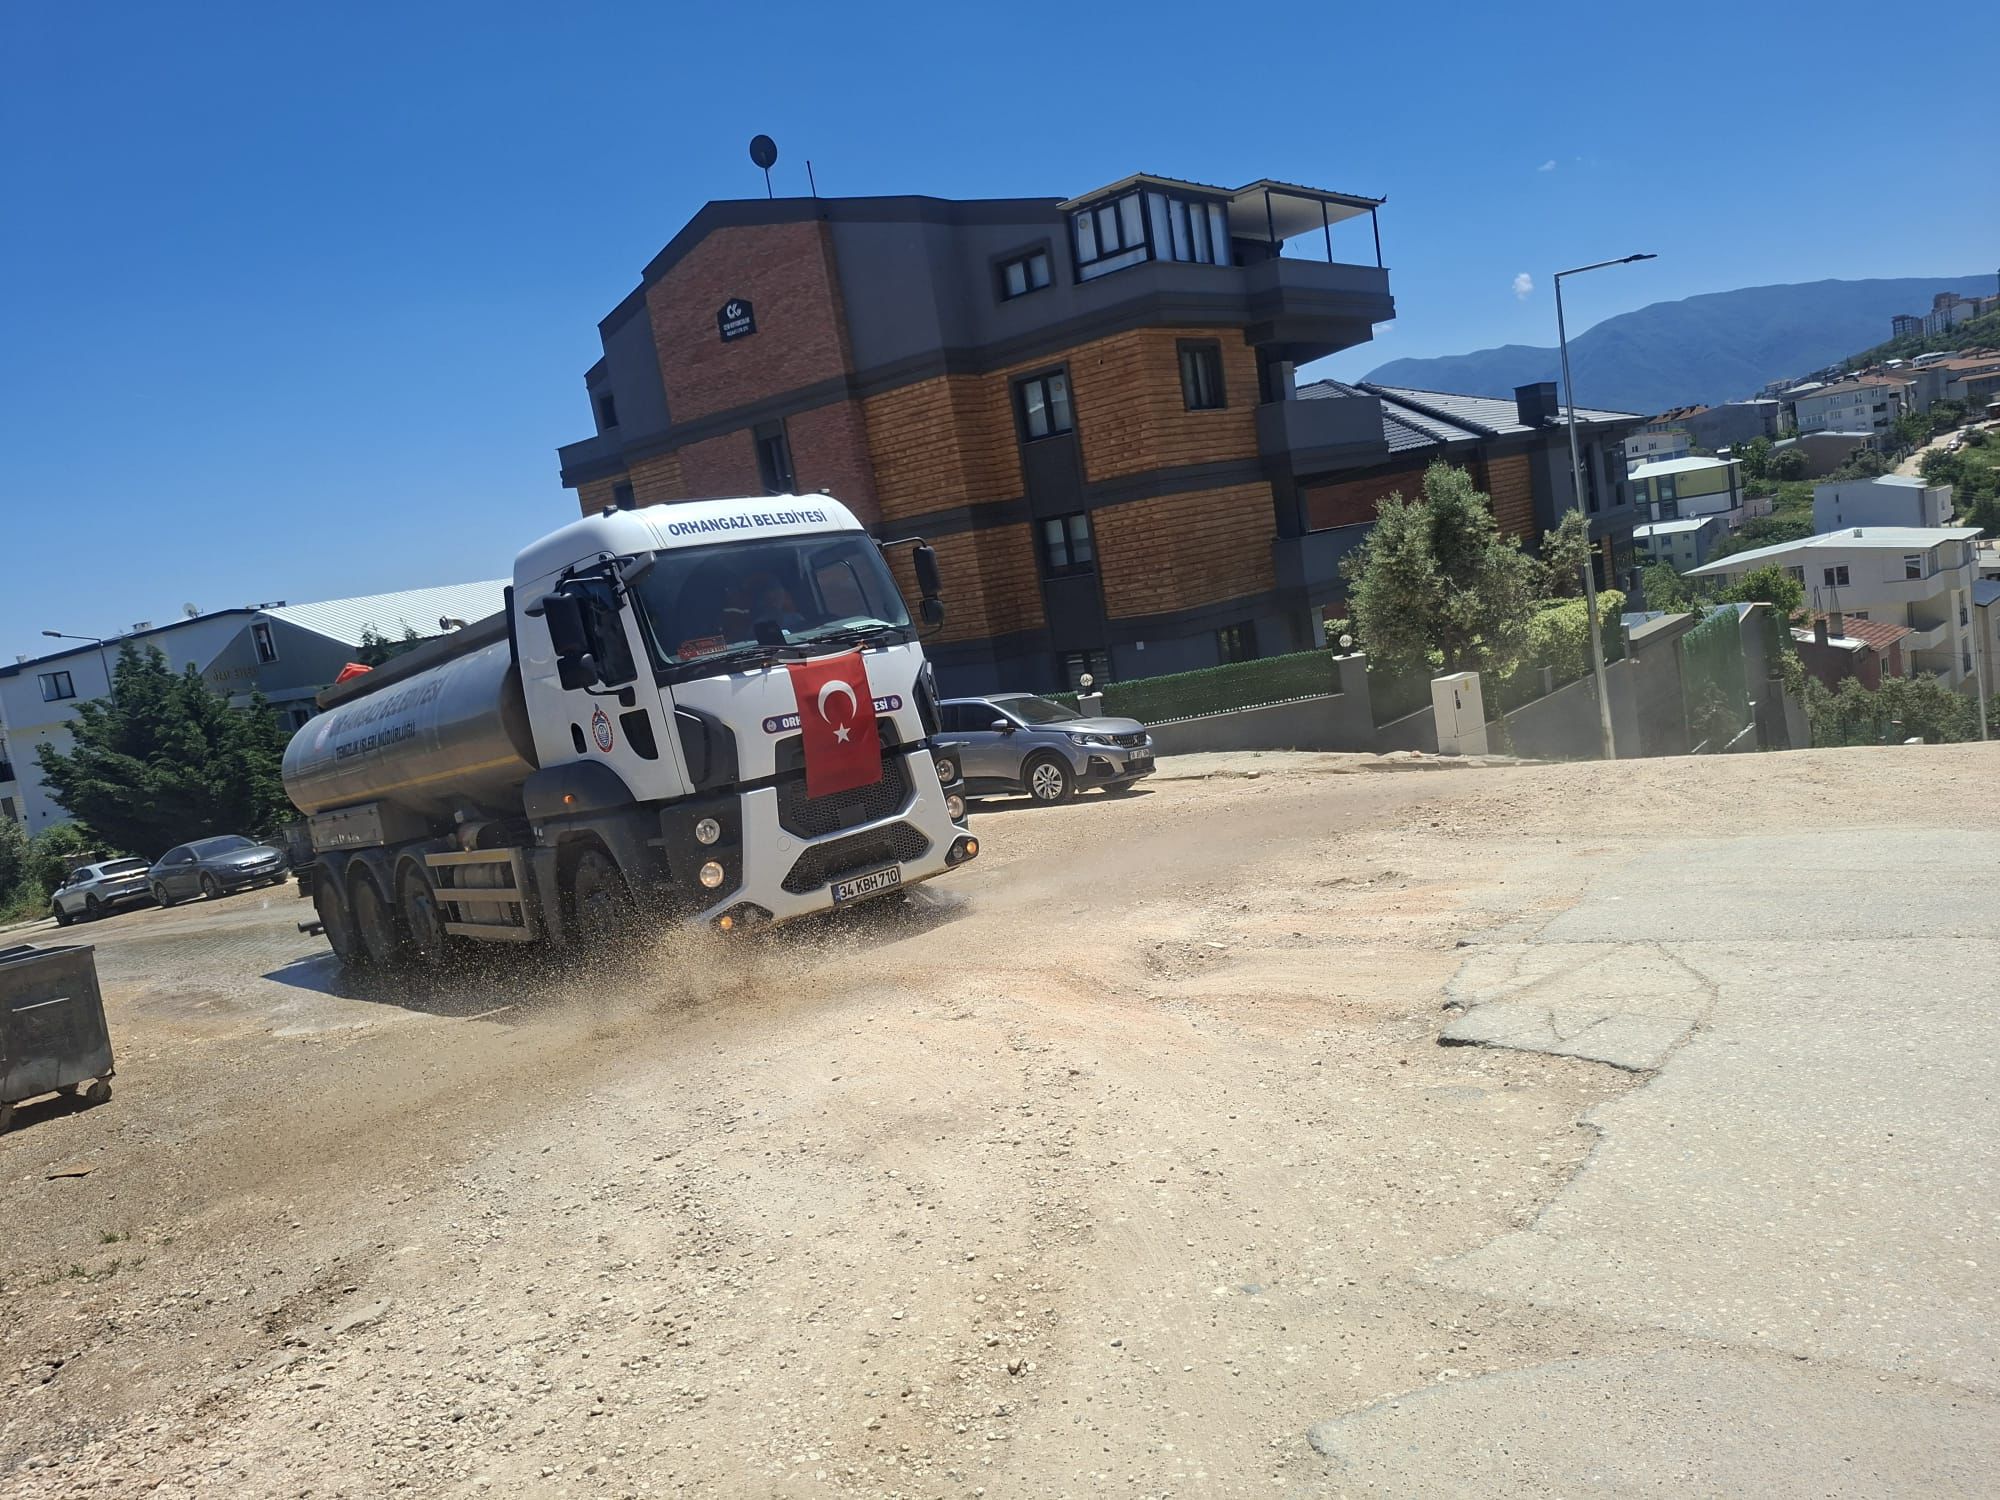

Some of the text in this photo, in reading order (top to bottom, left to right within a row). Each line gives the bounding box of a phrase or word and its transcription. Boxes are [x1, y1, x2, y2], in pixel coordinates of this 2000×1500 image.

[668, 508, 828, 536] ORHANGAZİ BELEDİYESİ
[840, 870, 898, 898] 34 KBH 710
